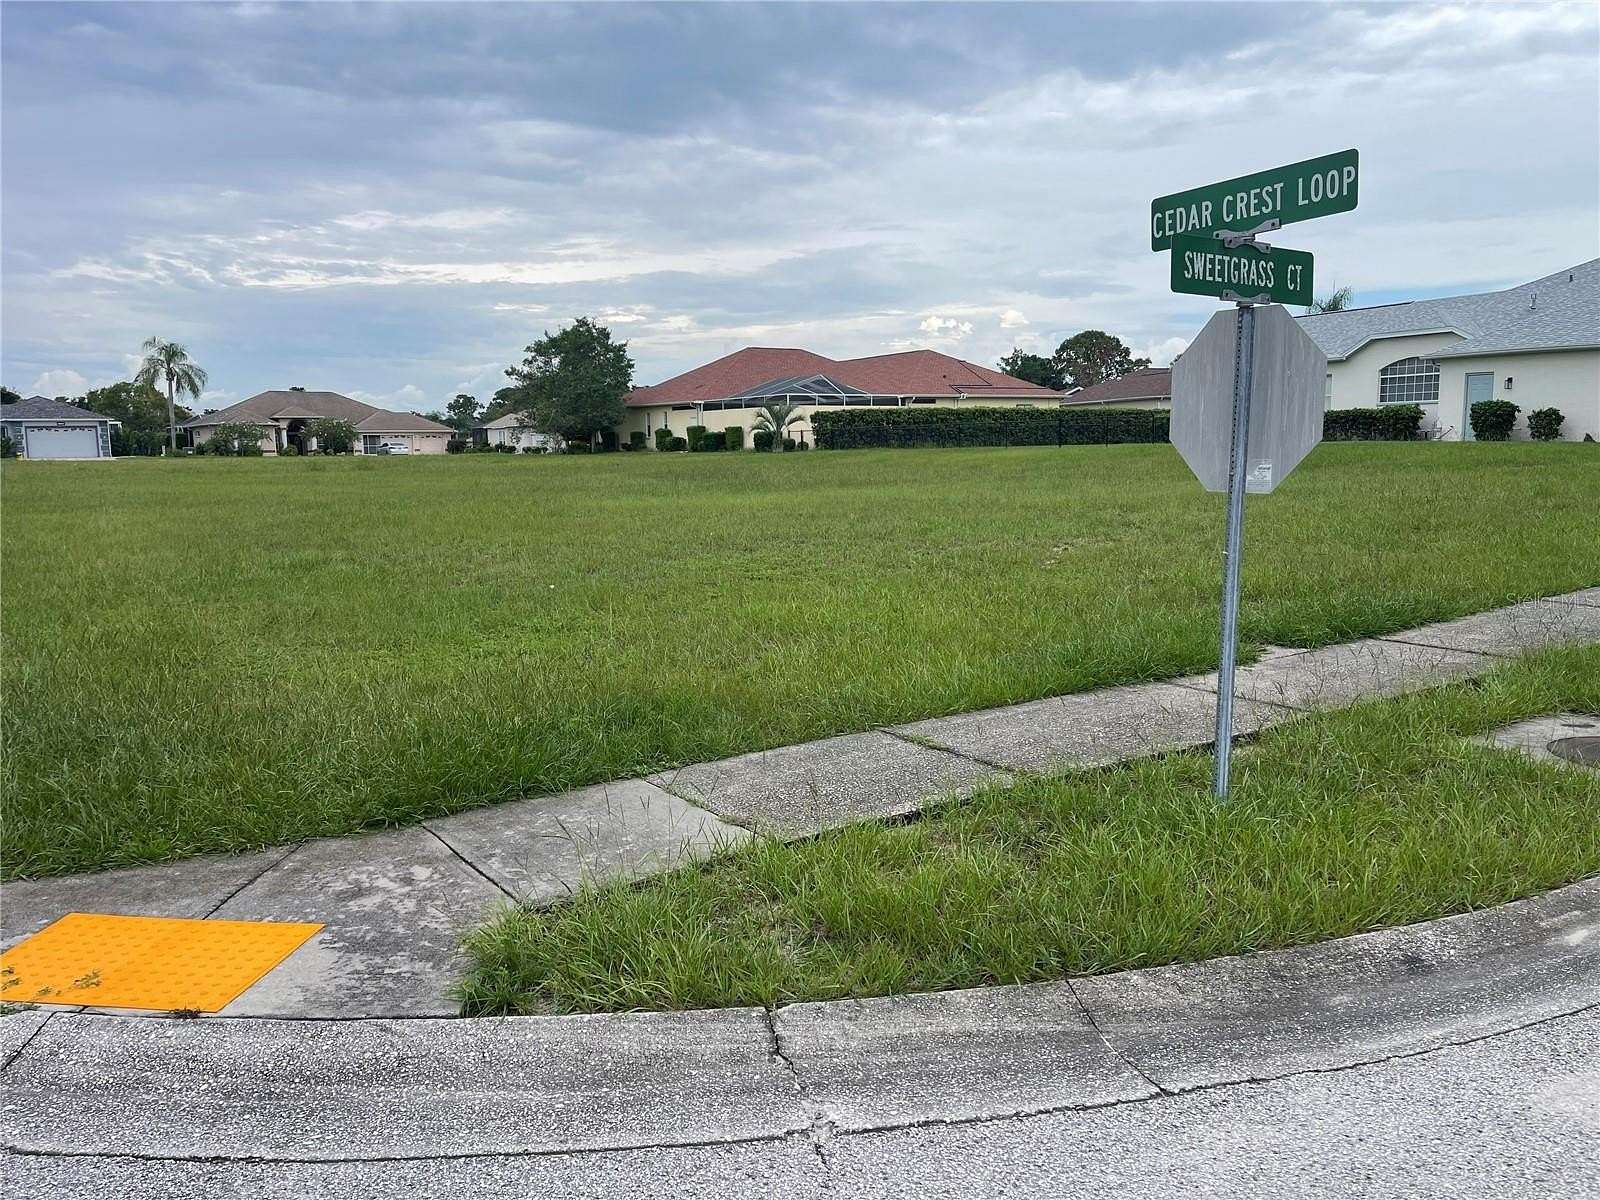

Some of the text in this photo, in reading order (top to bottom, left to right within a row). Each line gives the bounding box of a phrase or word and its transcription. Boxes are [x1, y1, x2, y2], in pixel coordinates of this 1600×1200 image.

[1153, 166, 1356, 238] CEDAR CREST LOOP
[1184, 251, 1303, 291] SWEETGRASS CT
